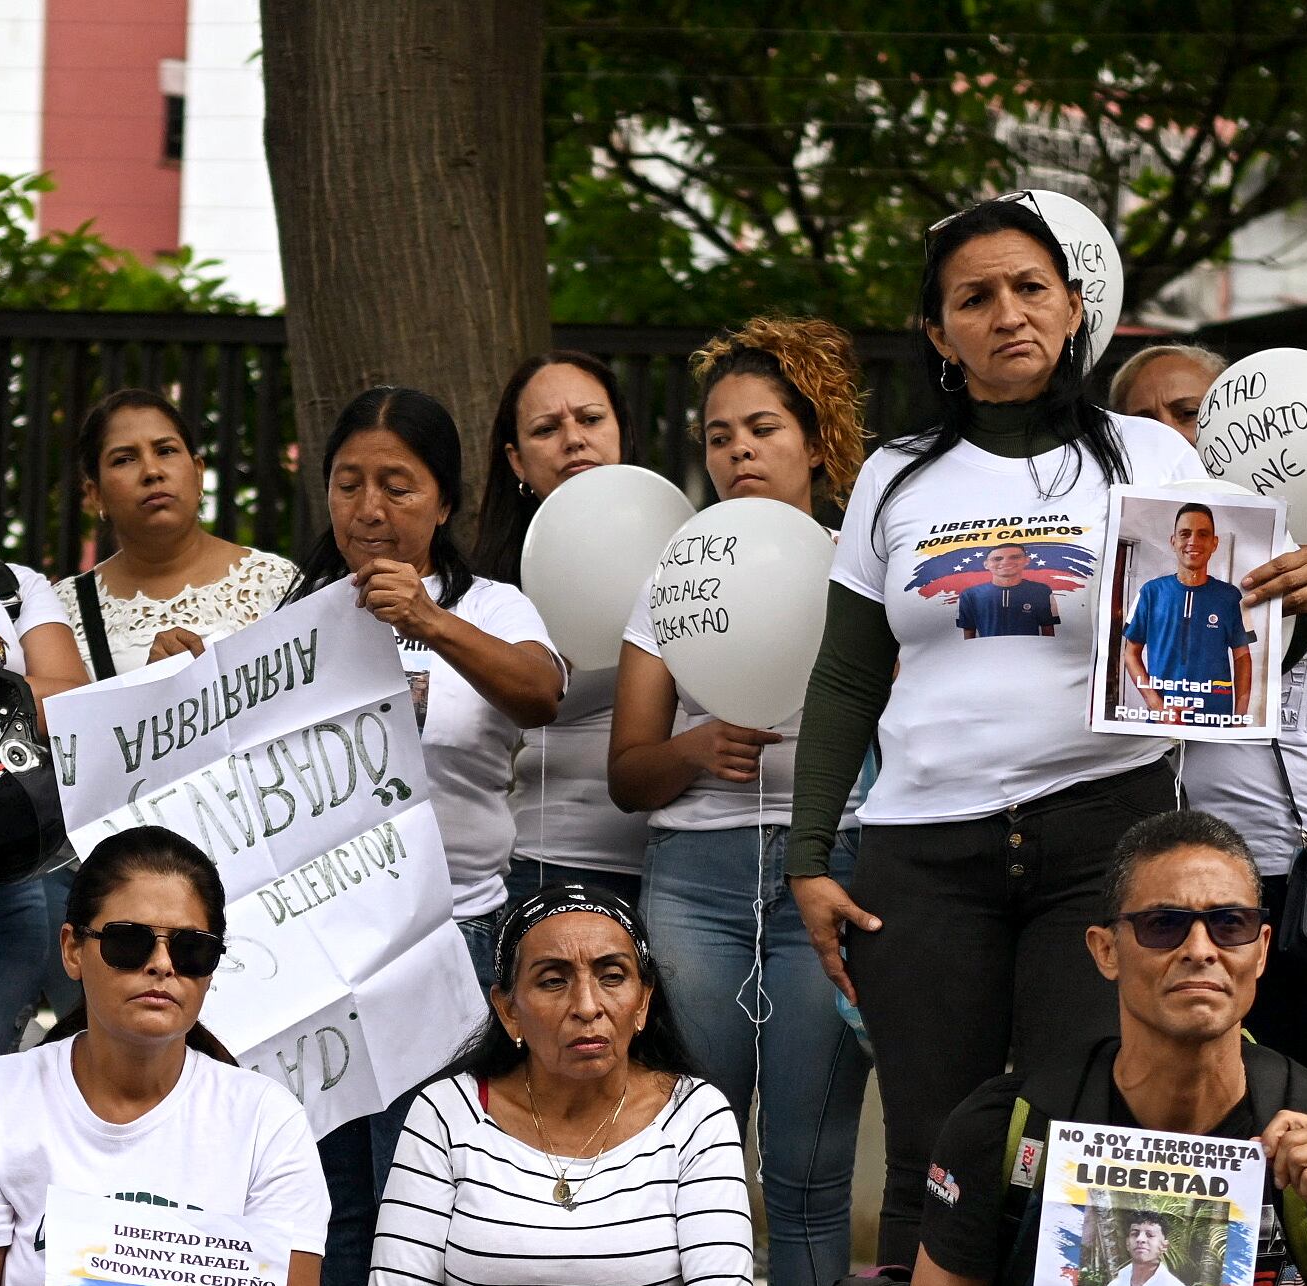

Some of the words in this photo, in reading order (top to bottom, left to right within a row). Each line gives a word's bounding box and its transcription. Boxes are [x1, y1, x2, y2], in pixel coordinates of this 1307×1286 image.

[914, 532, 995, 551] ROBERT
[997, 526, 1084, 541] CAMPOS
[929, 516, 1024, 535] LIBERTAD
[1027, 514, 1070, 525] PARA
[649, 578, 721, 610] GONZALEZ
[1136, 675, 1212, 693] Libertad
[1163, 695, 1205, 709] para
[1114, 705, 1179, 722] Robert
[1180, 710, 1254, 728] Campos
[1058, 1128, 1084, 1143] NO
[1093, 1132, 1132, 1148] SOY
[1140, 1137, 1261, 1161] TERRORISTA
[1083, 1144, 1103, 1158] NI
[1111, 1148, 1243, 1172] DELINCUENTE
[1076, 1163, 1230, 1198] LIBERTAD
[113, 1223, 201, 1246] LIBERTAD
[204, 1236, 253, 1253] PARA
[90, 1256, 196, 1284] SOTOMAYOR
[114, 1243, 176, 1263] DANNY
[179, 1253, 250, 1272] RAFAEL
